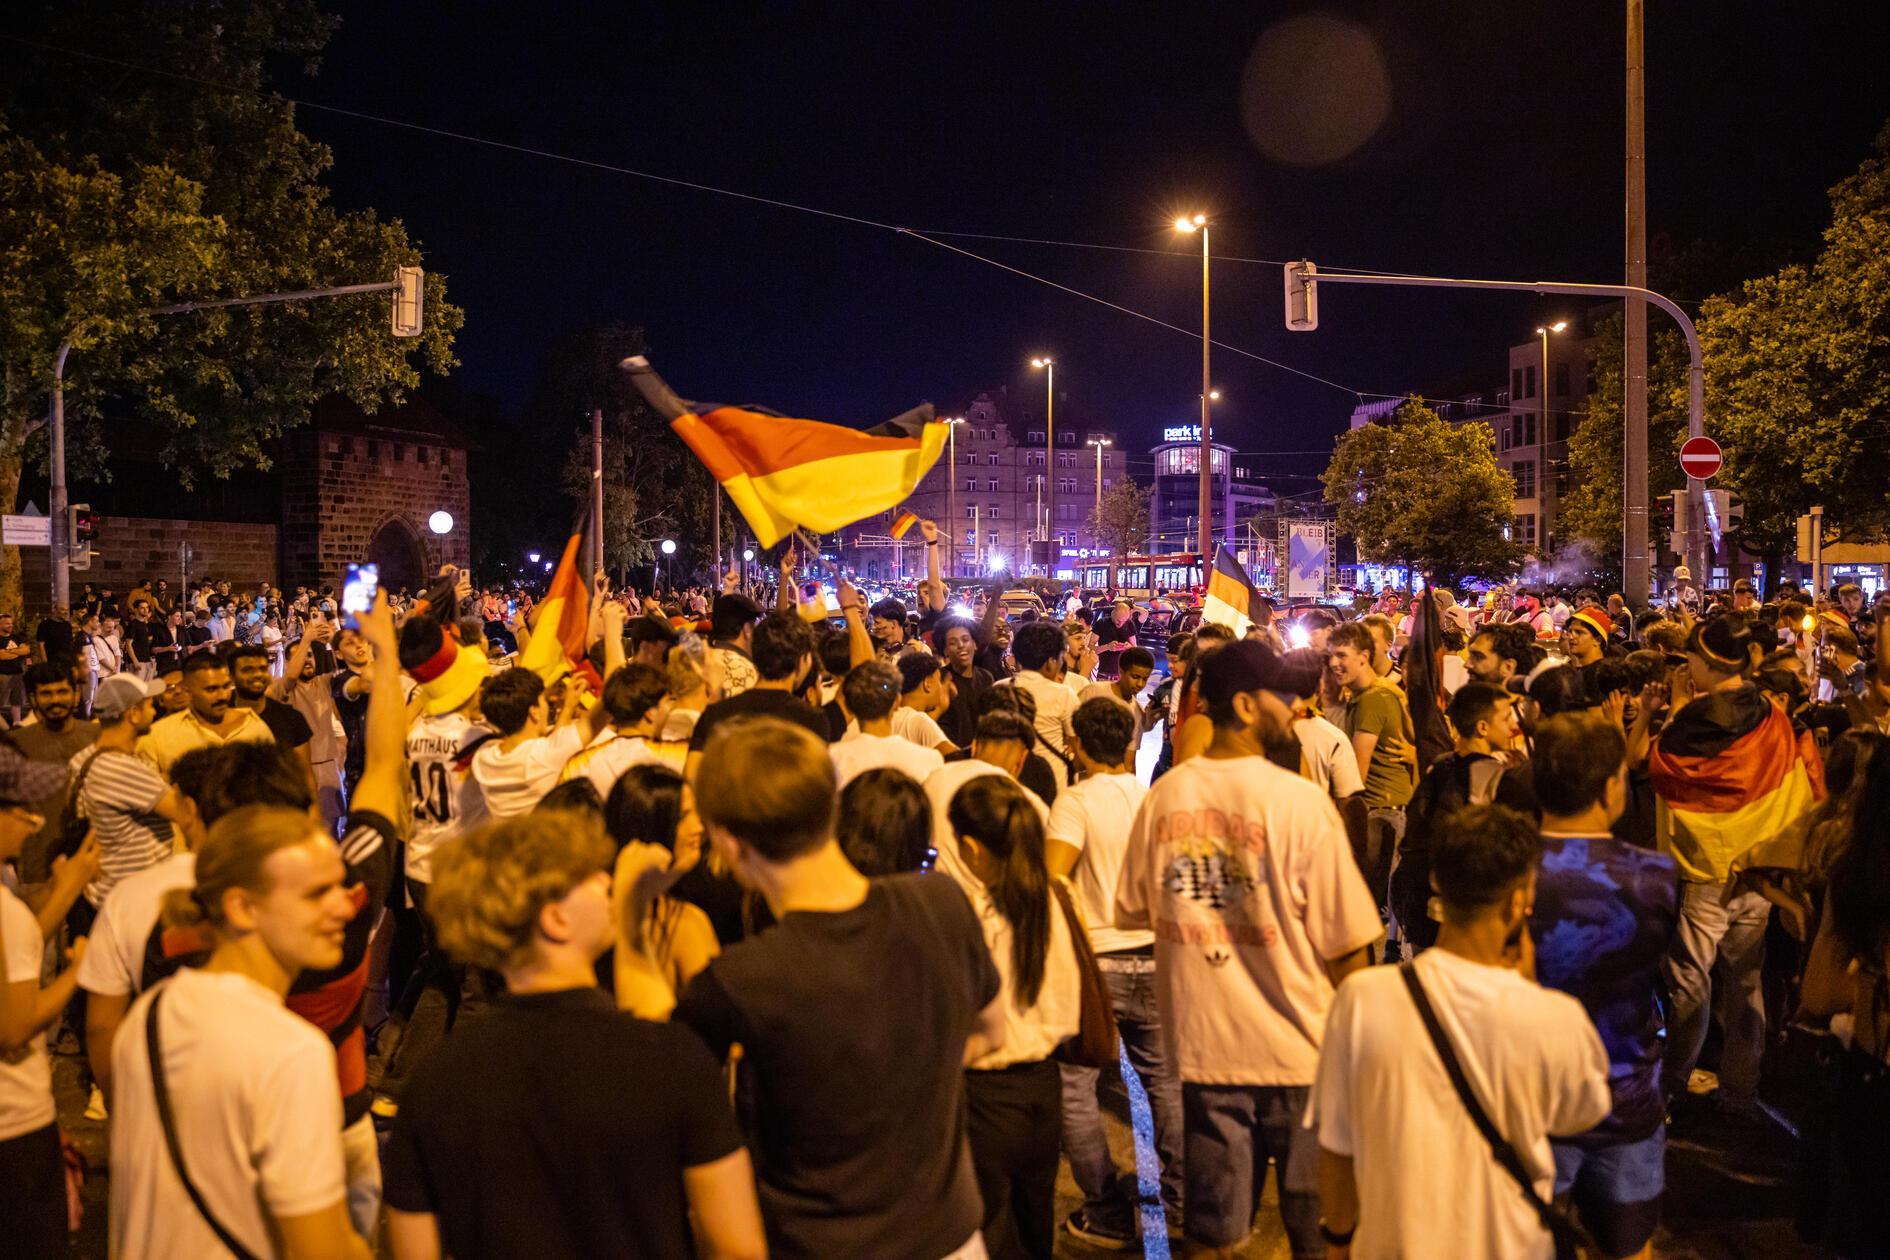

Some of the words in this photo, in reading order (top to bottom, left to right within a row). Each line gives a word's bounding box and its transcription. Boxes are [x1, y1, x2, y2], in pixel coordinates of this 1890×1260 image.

[1164, 425, 1191, 441] park
[1193, 425, 1212, 436] in
[1297, 527, 1323, 538] BLEIB
[411, 761, 451, 822] 10
